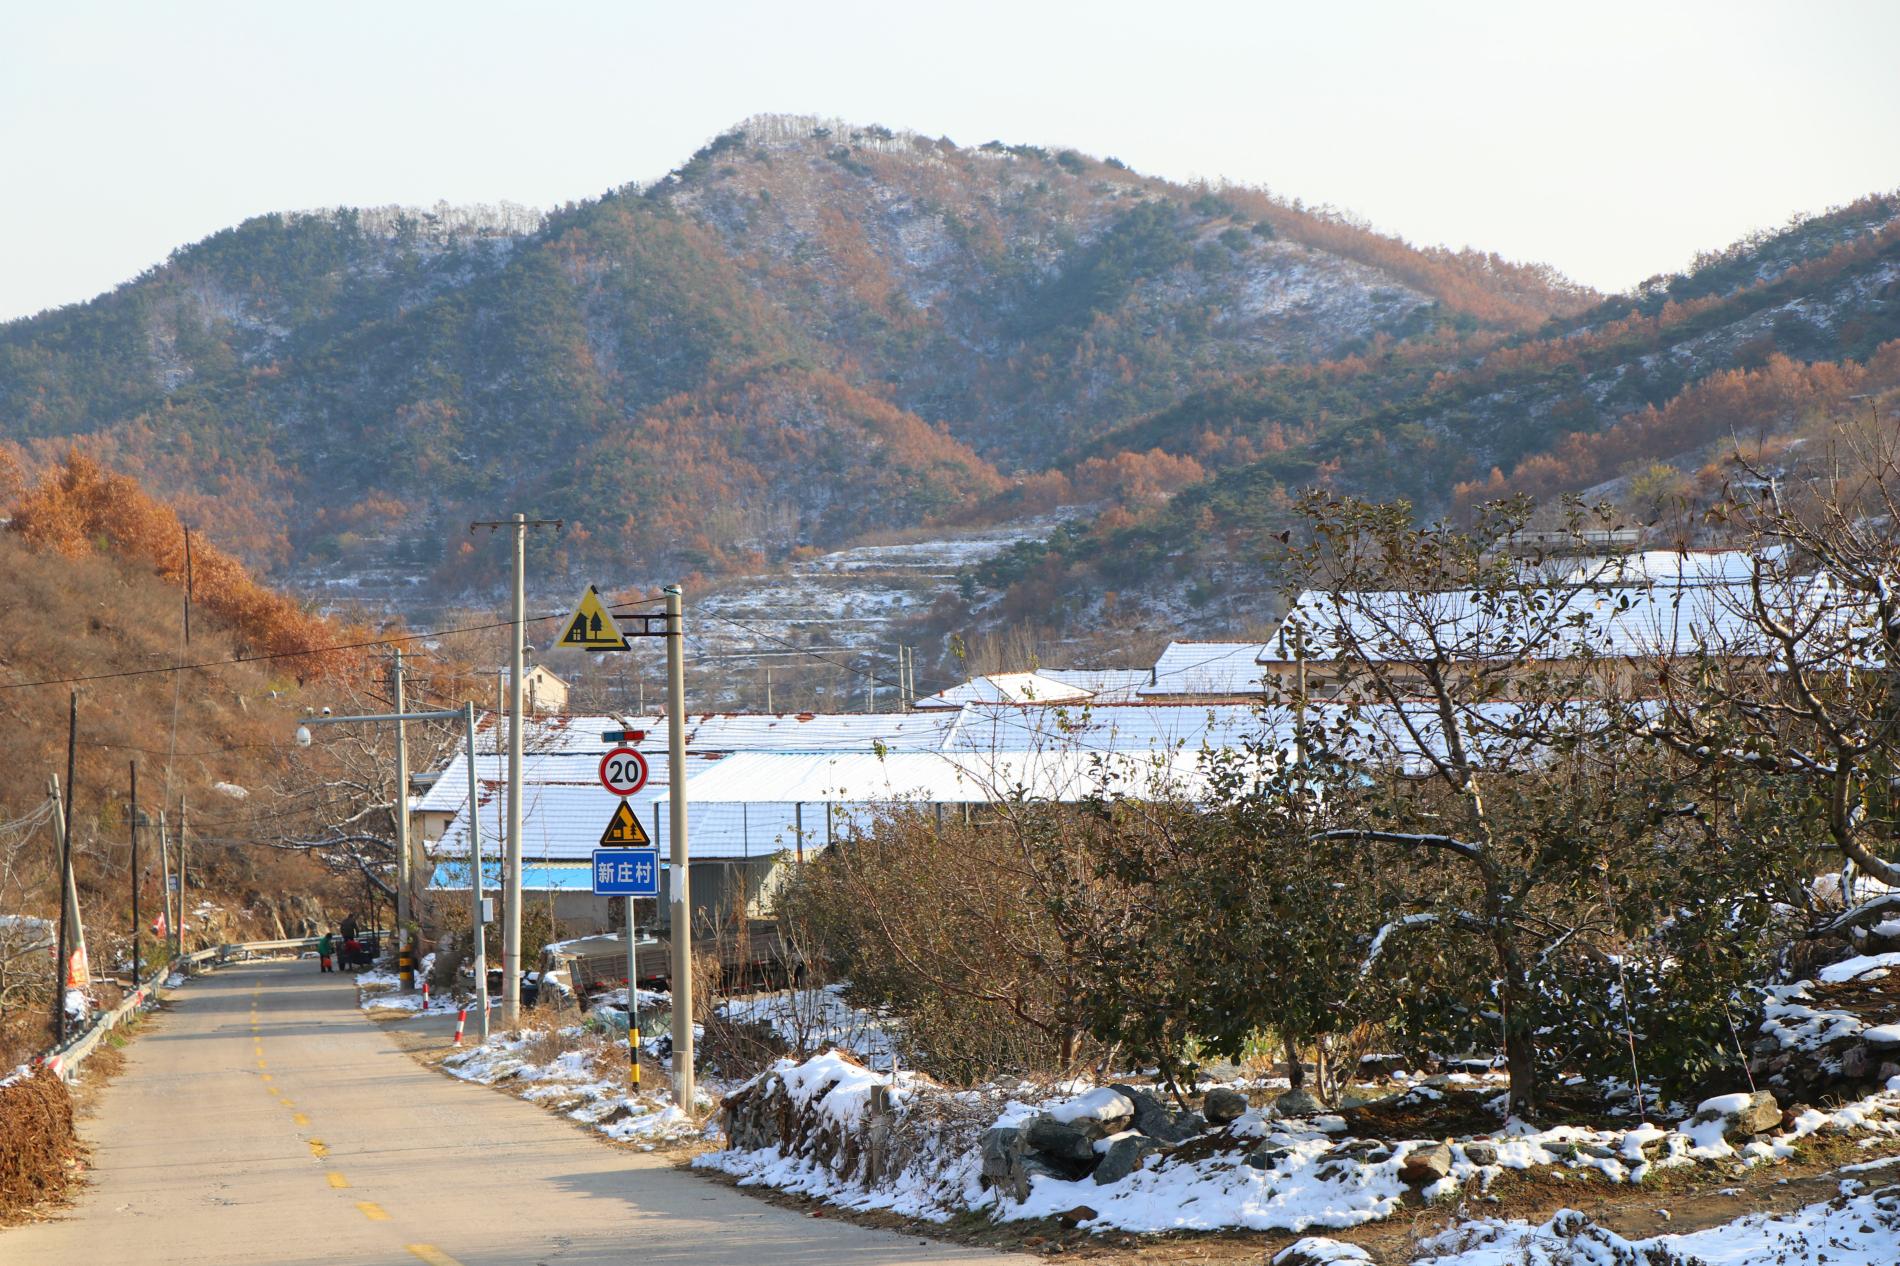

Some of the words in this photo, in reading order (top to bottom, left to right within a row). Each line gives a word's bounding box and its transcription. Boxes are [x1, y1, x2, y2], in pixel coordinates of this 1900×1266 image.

[609, 760, 638, 783] 20
[598, 862, 652, 884] 新庄村
